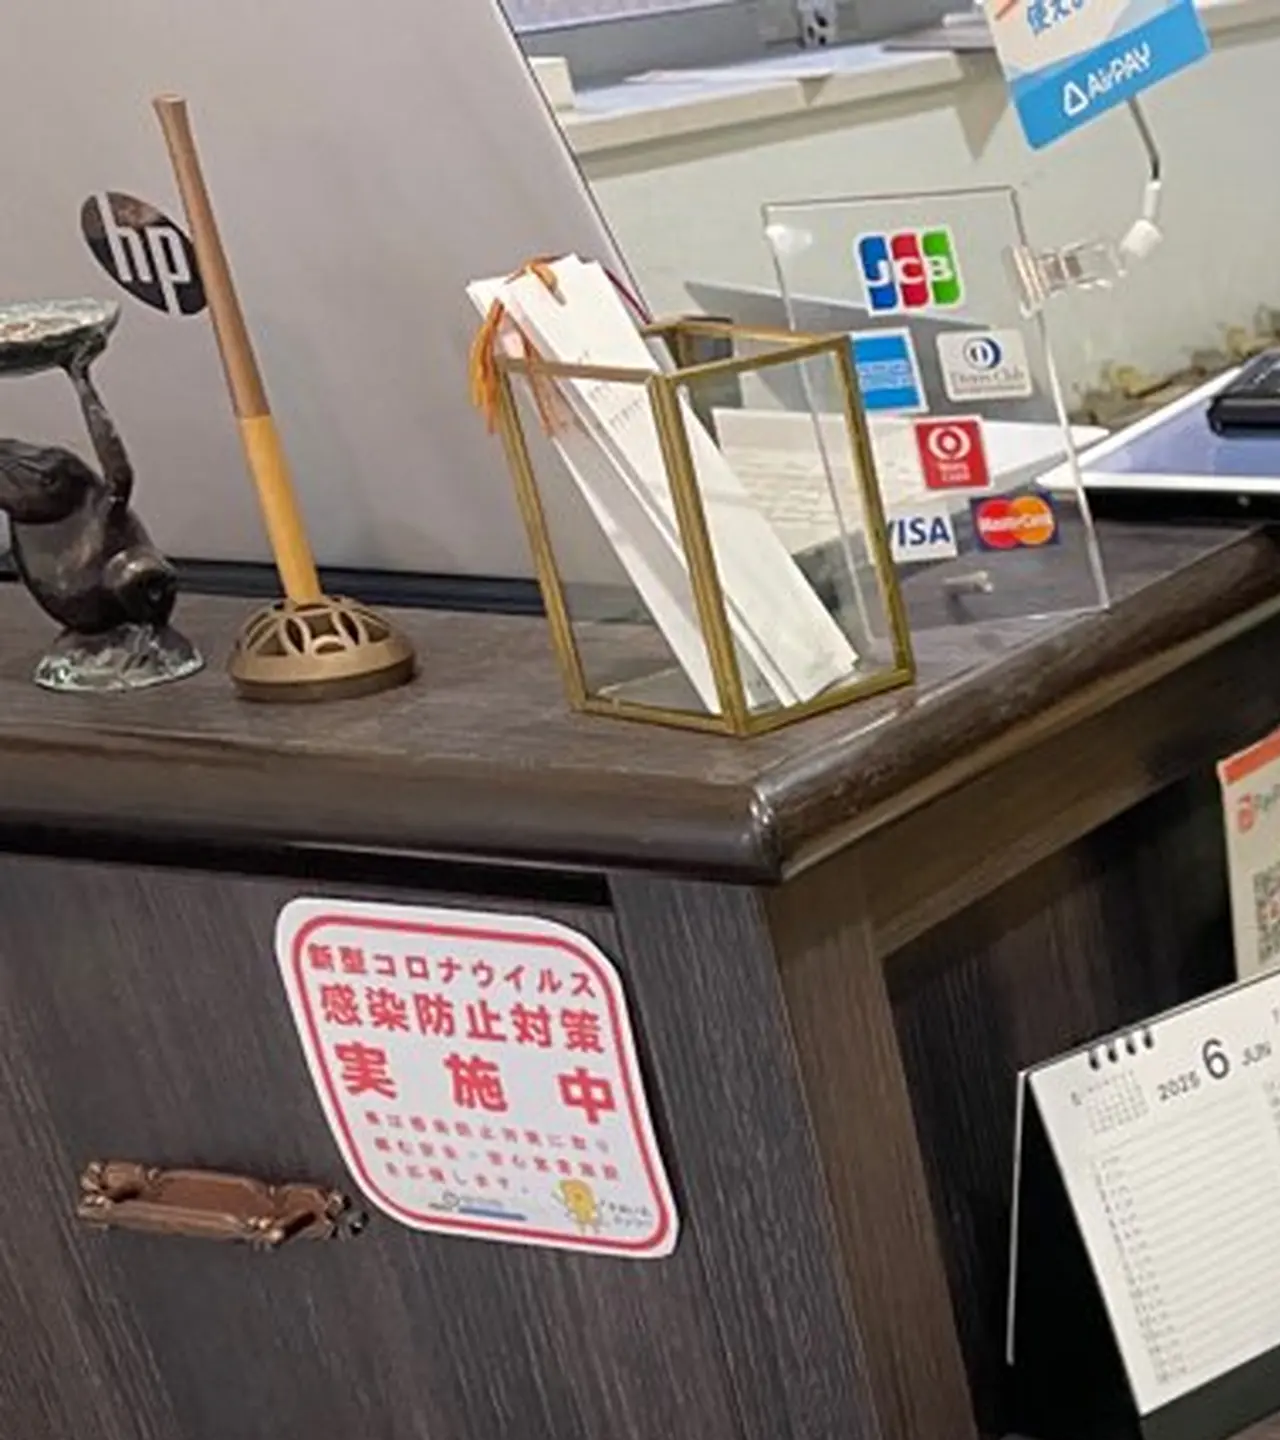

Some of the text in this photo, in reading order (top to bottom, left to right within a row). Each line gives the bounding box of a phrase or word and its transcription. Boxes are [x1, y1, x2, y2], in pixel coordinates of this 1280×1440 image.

[95, 192, 191, 315] hp
[307, 942, 597, 999] 新型コロナウイルス
[319, 982, 607, 1054] 感染防止対策
[1201, 1037, 1230, 1080] 6
